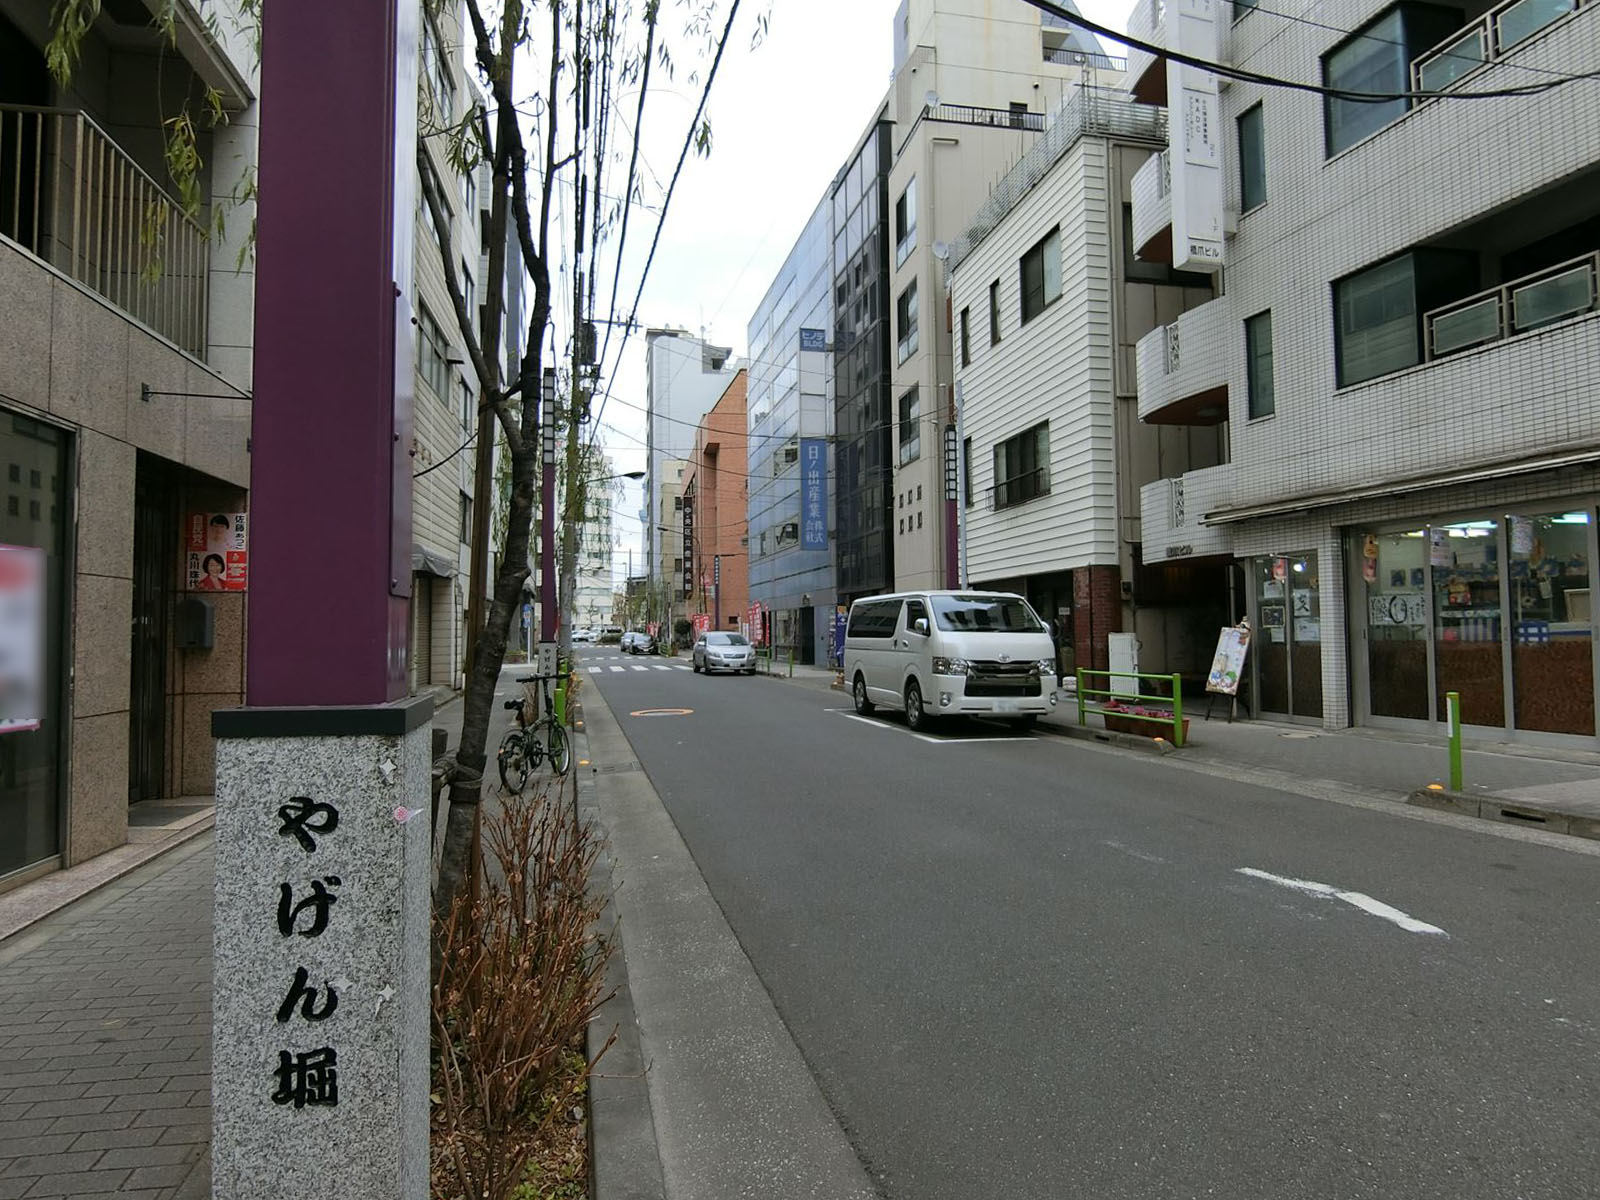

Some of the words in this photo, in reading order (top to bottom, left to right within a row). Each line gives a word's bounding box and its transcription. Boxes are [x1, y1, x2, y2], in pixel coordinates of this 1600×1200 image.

[803, 340, 825, 348] BLDG
[235, 515, 245, 549] 佐藤あつこ
[272, 796, 342, 1108] やげん堀
